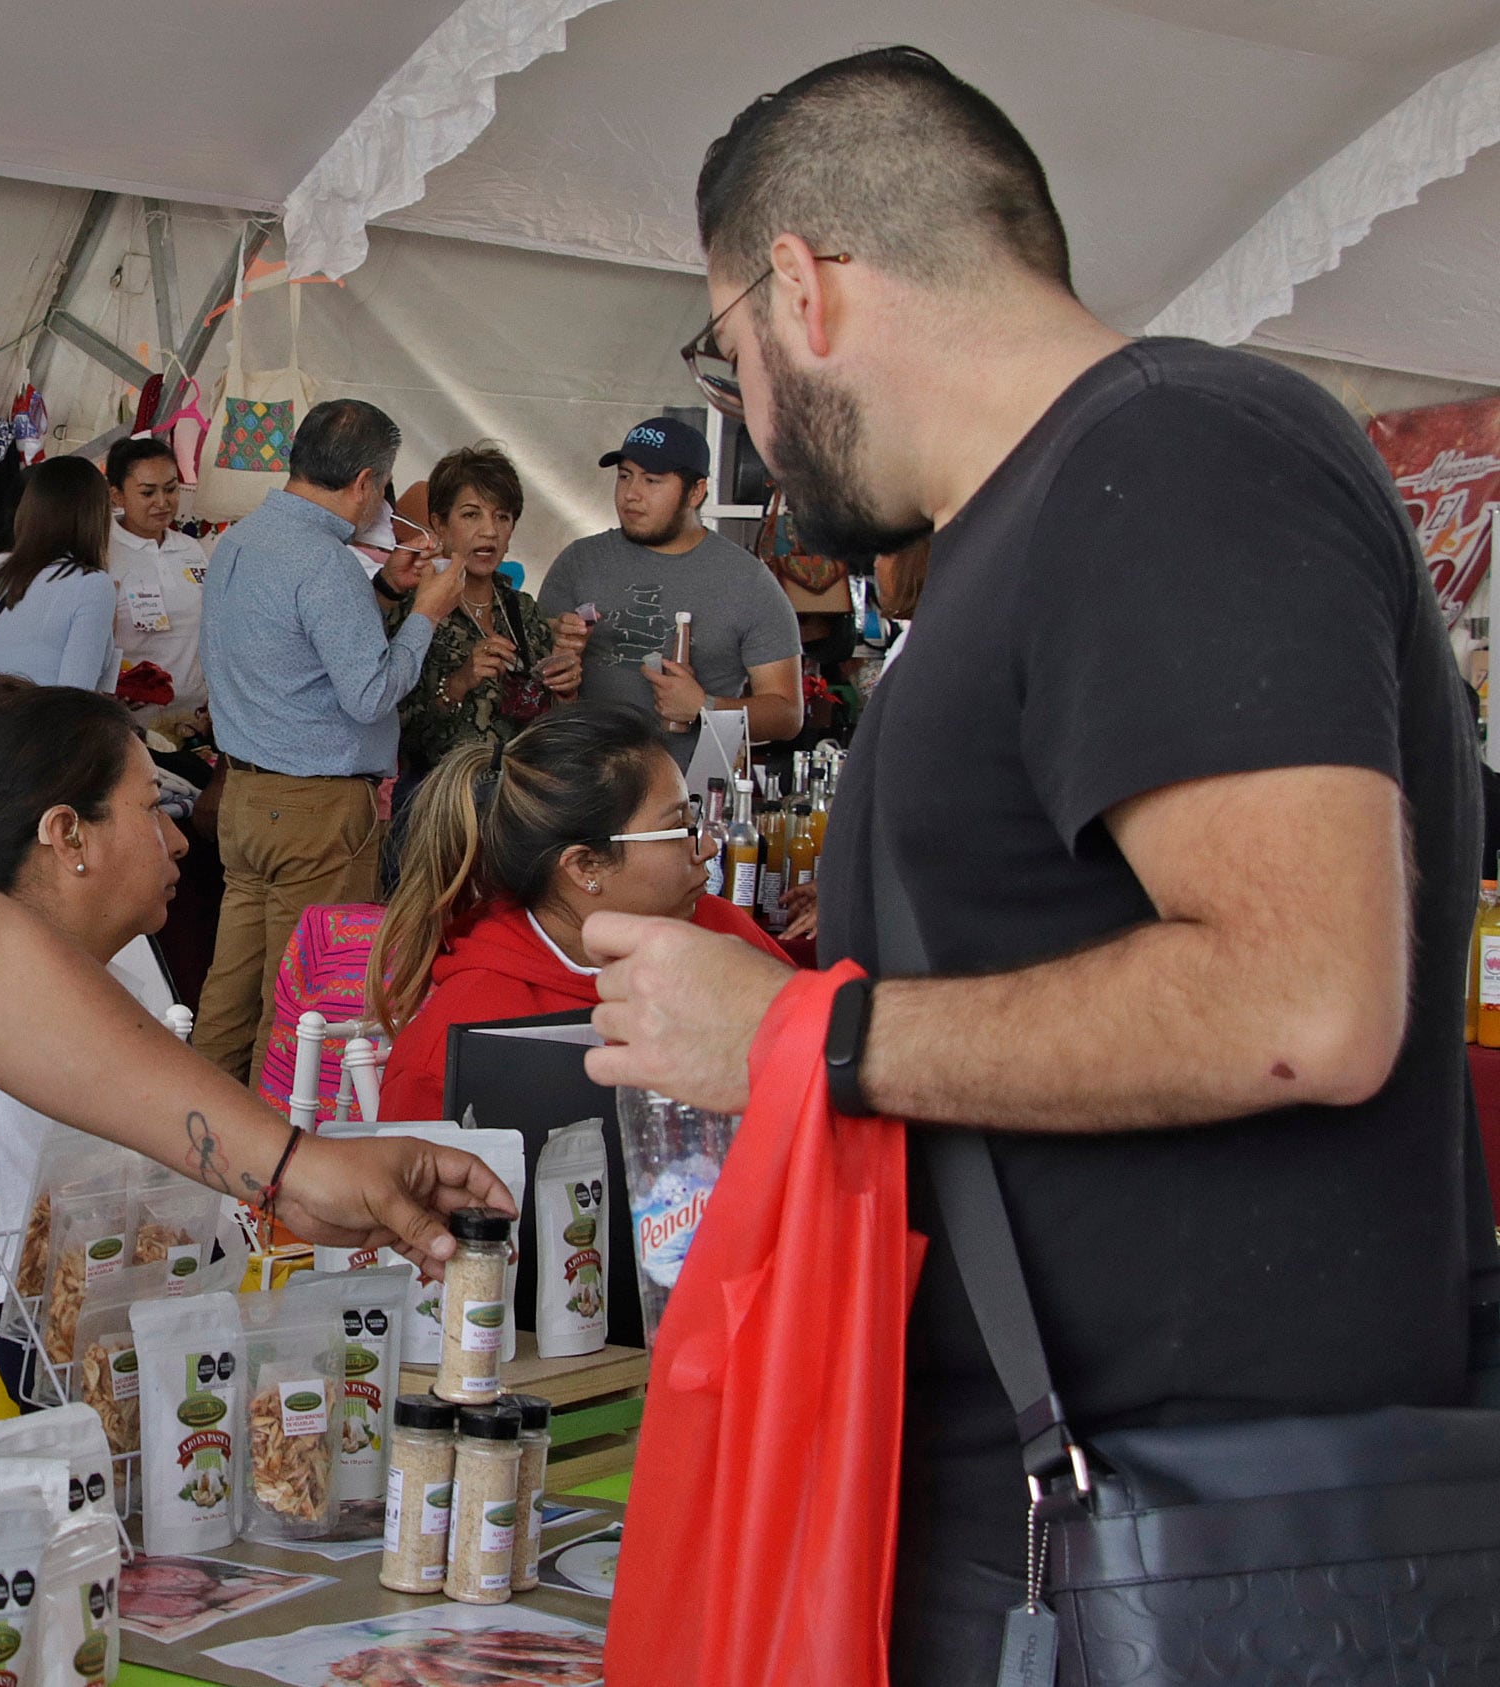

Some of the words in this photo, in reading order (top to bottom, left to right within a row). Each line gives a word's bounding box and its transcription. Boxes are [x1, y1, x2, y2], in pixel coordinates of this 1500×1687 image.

[640, 1188, 706, 1262] Peñafi
[353, 1251, 372, 1265] AJO
[352, 1383, 378, 1399] PASTA
[182, 1440, 197, 1454] AJO
[196, 1434, 207, 1448] EN
[208, 1432, 230, 1447] PASTA
